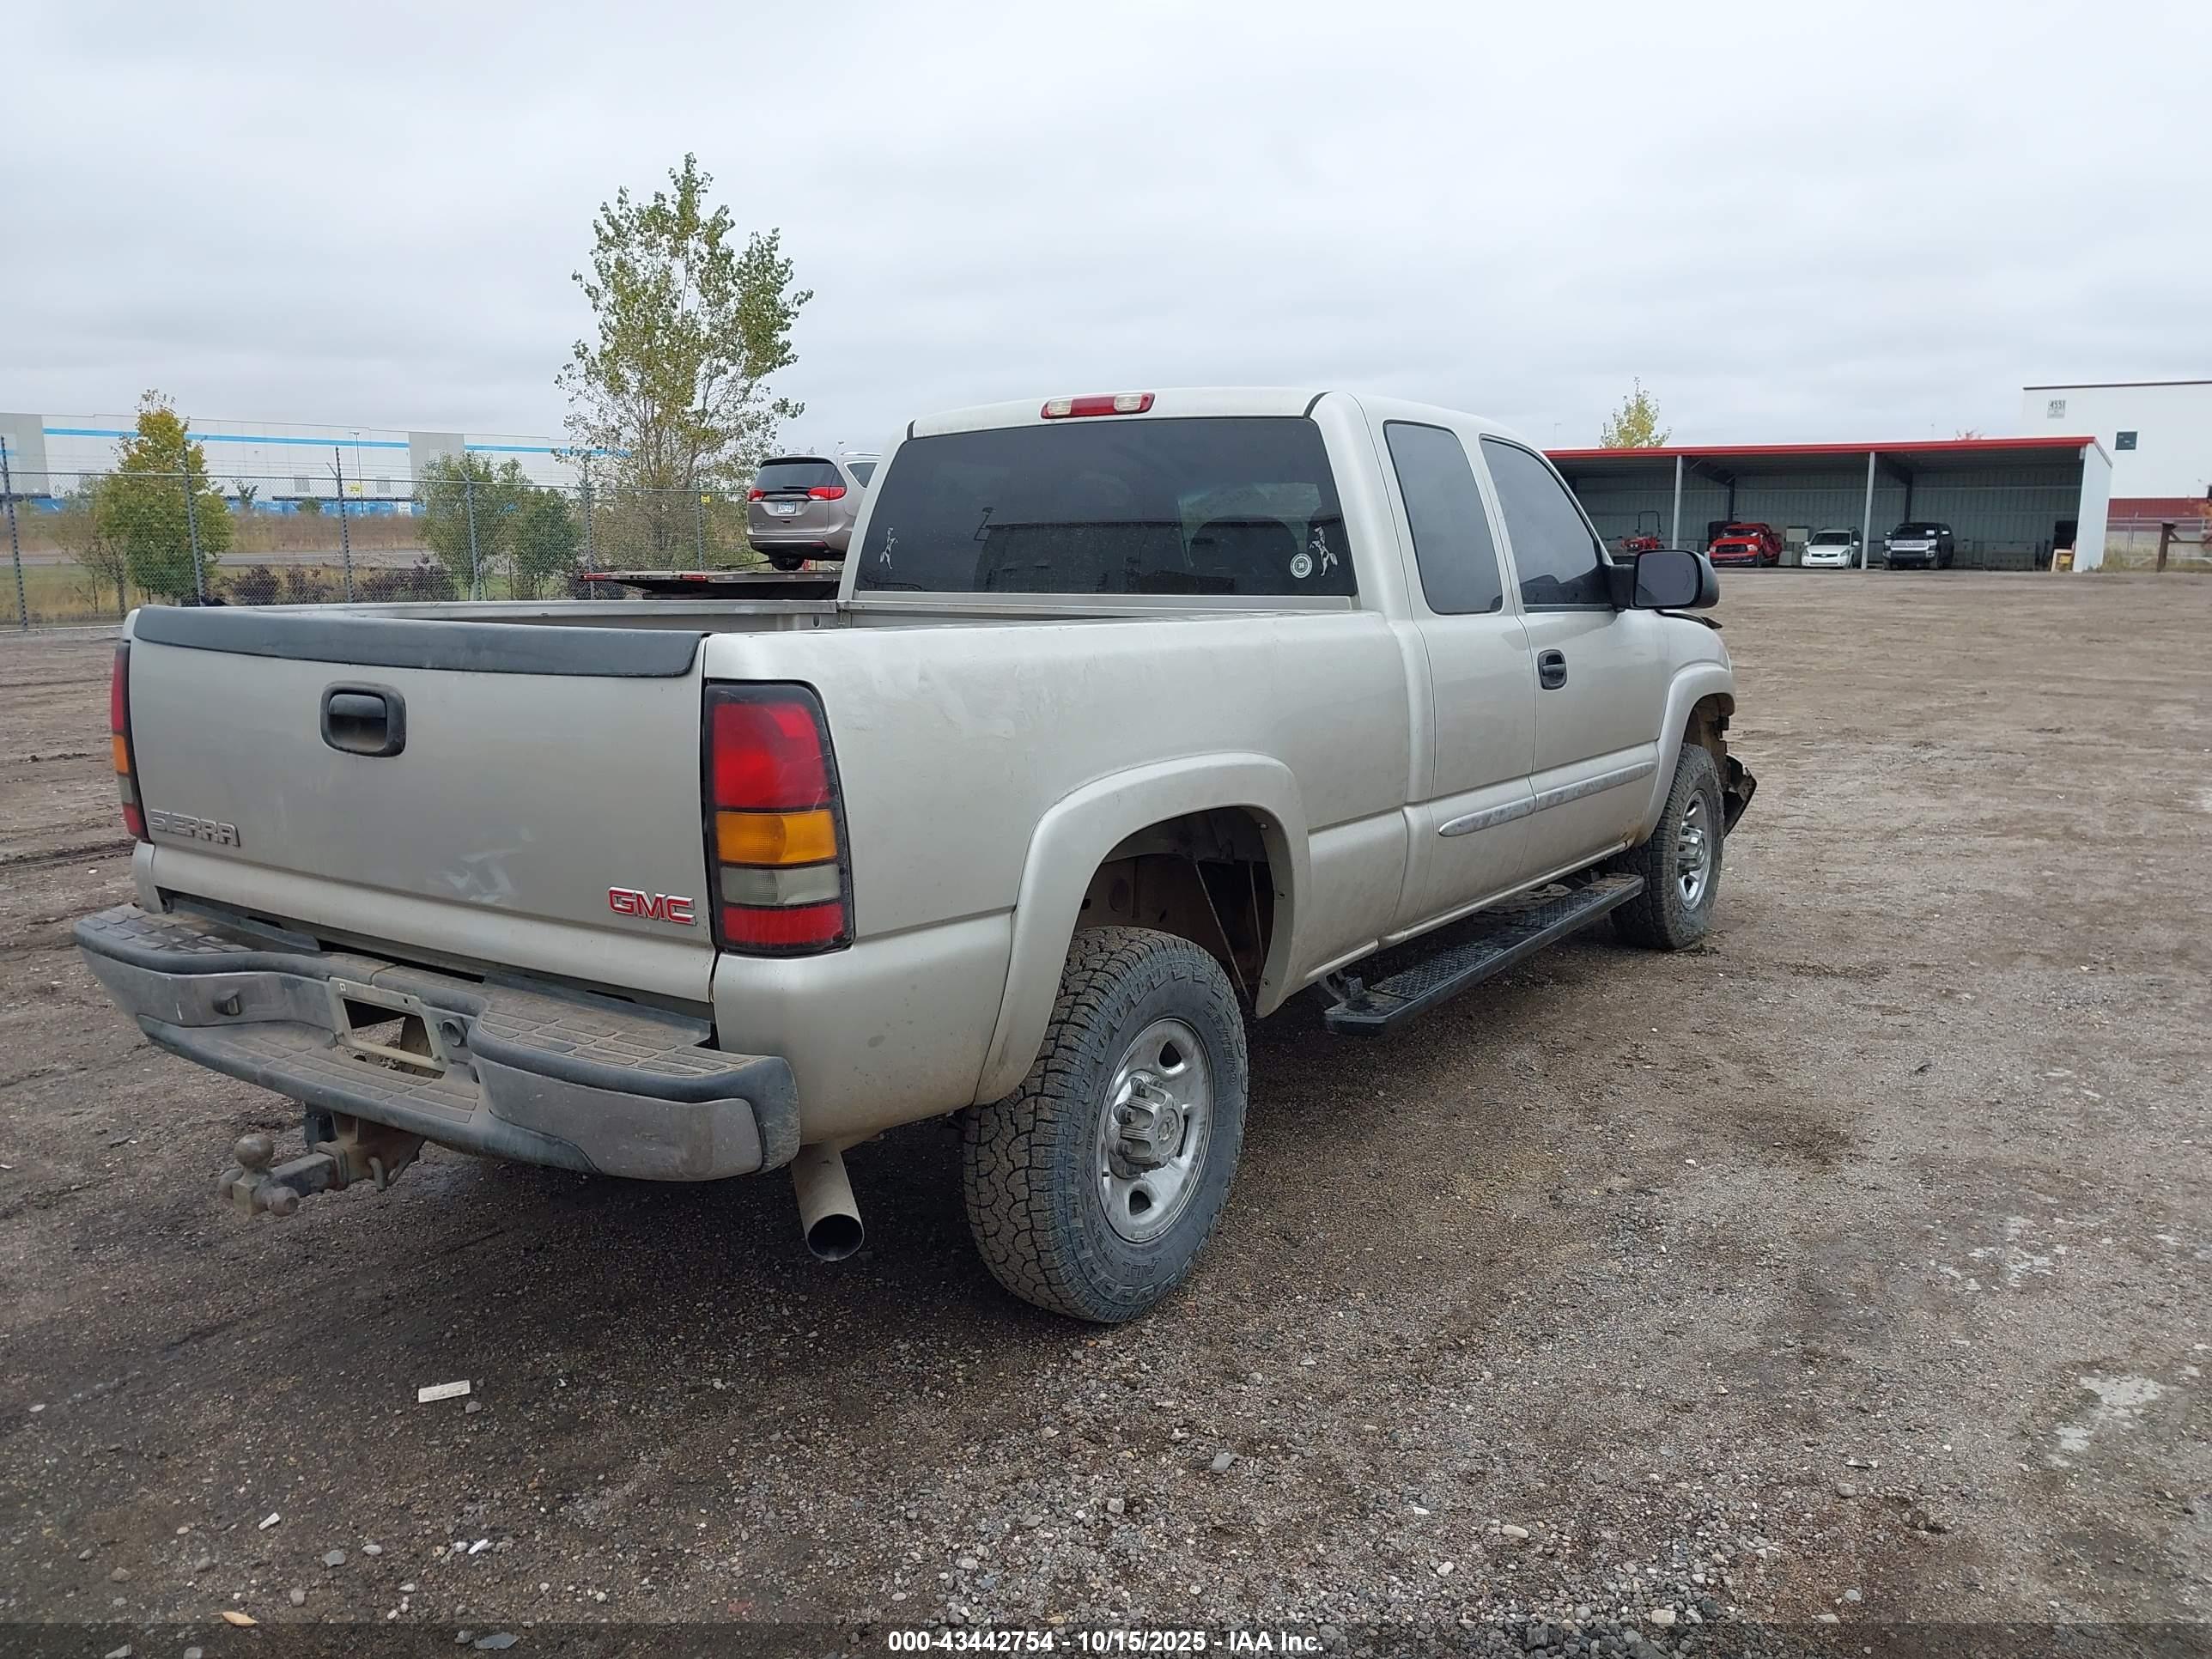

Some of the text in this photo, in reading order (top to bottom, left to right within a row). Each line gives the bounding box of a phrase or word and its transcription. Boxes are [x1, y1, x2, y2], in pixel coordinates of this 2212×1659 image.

[150, 809, 240, 847] SIERRA
[608, 886, 697, 927] GMC
[1120, 1256, 1162, 1278] ALL
